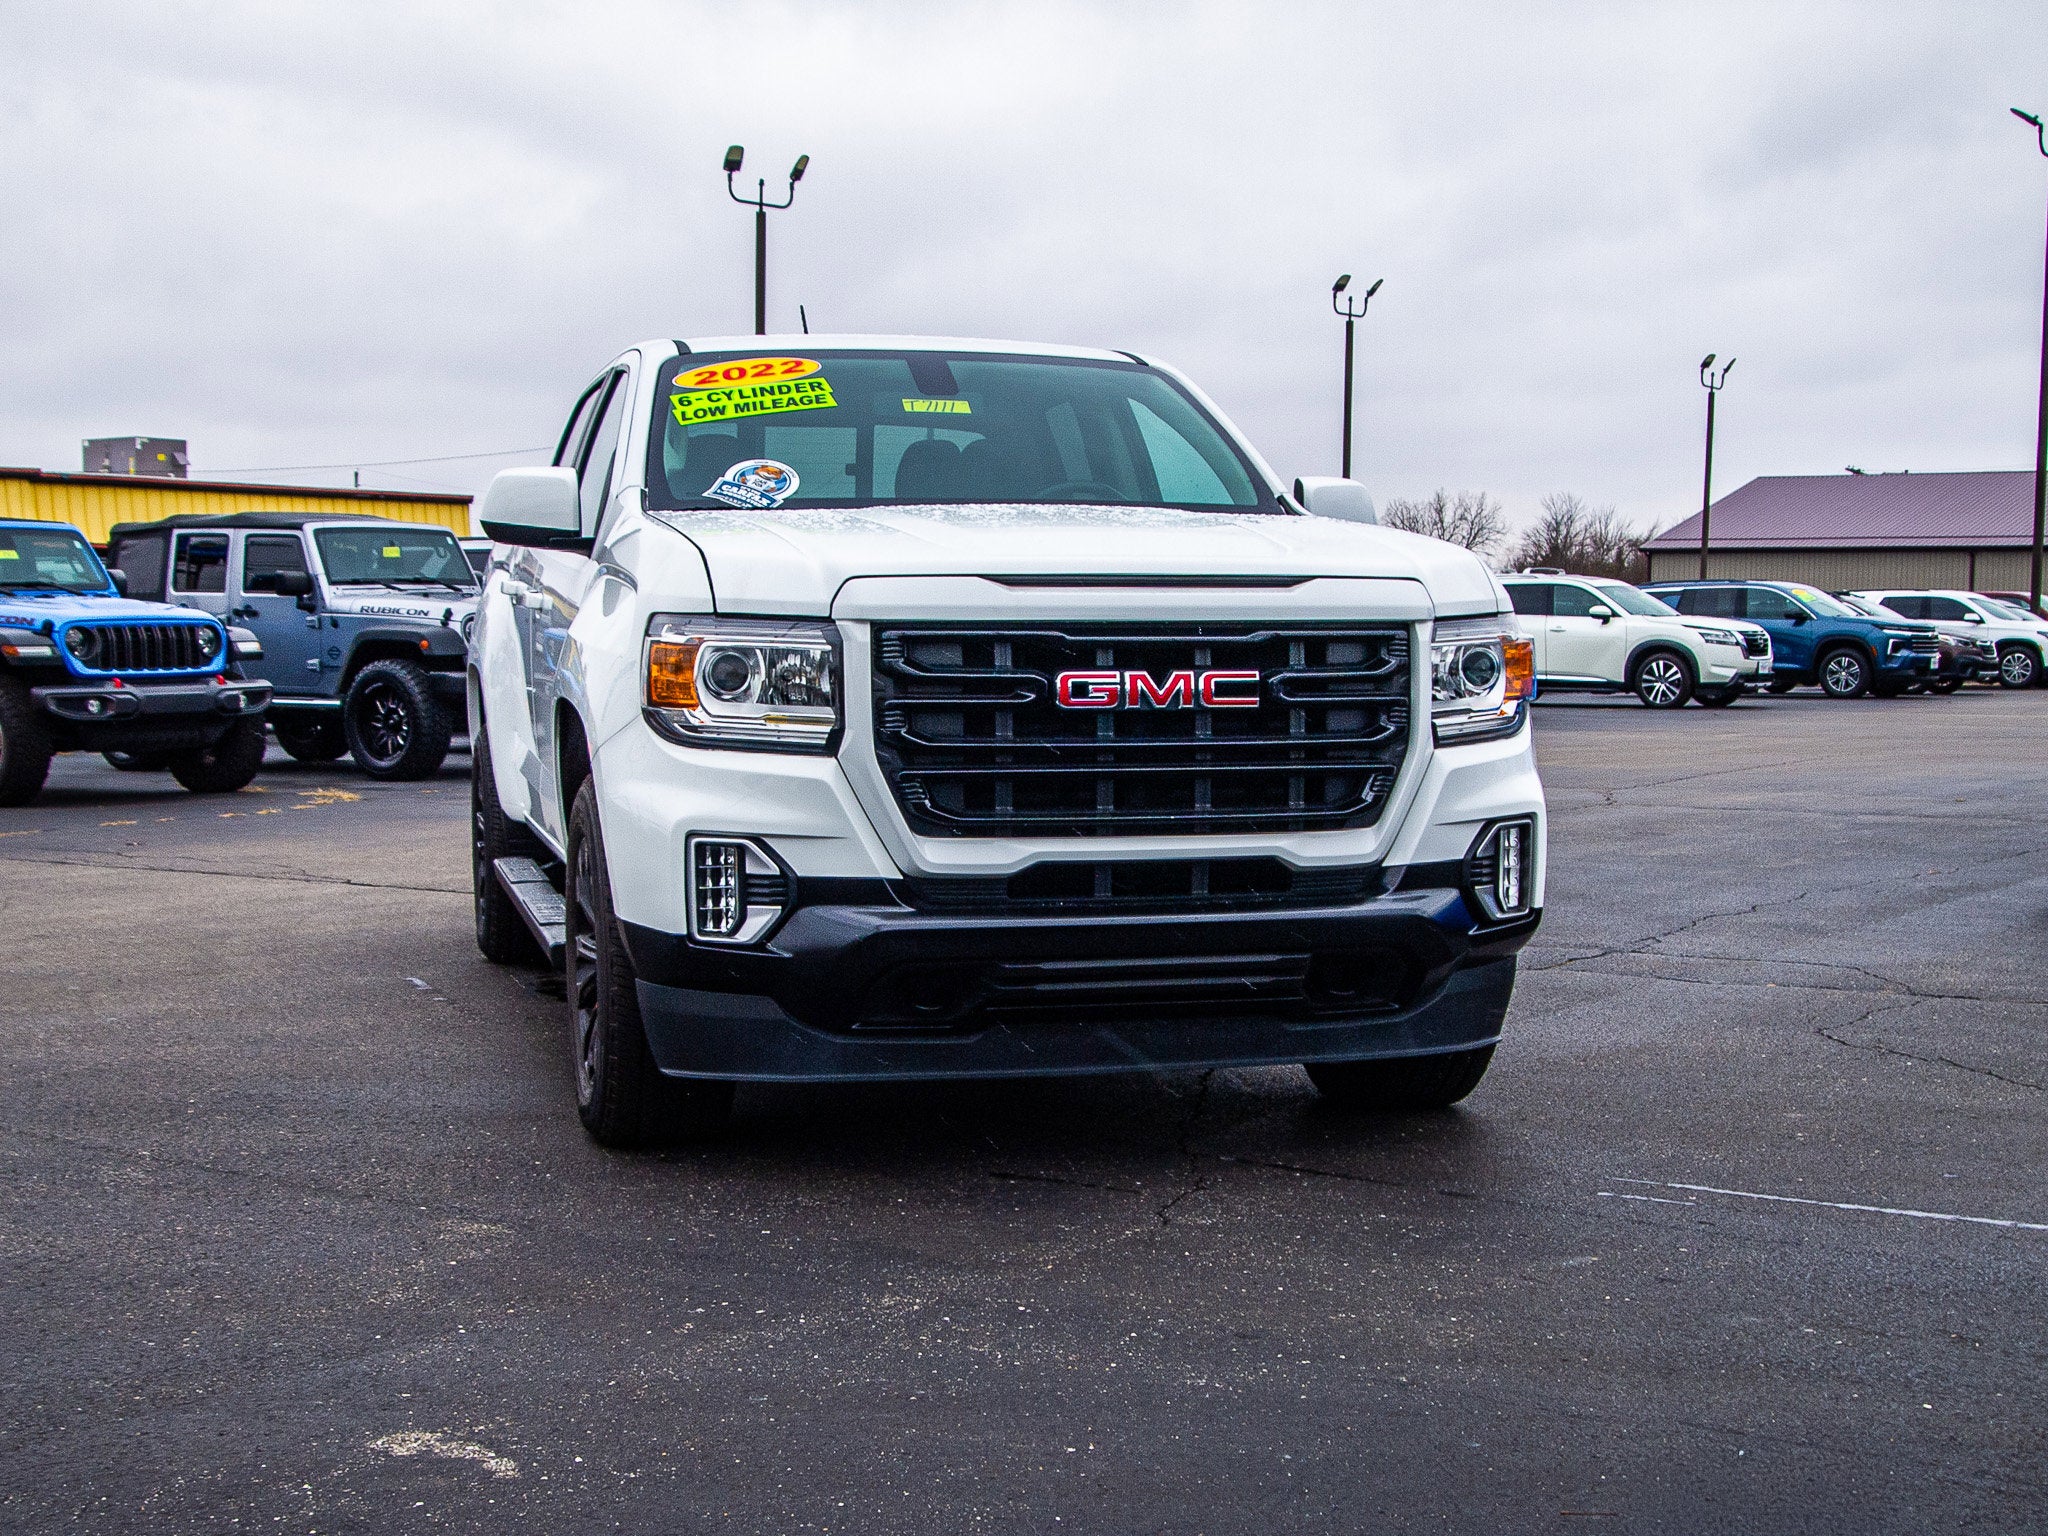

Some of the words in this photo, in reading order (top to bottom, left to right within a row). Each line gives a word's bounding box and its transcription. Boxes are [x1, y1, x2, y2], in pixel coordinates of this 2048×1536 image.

[694, 360, 805, 385] 2022
[678, 381, 826, 407] 6-CYLINDER
[681, 405, 728, 422] LOW
[735, 394, 828, 414] MILEAGE
[360, 606, 430, 616] RUBICON
[1055, 670, 1260, 709] GMC
